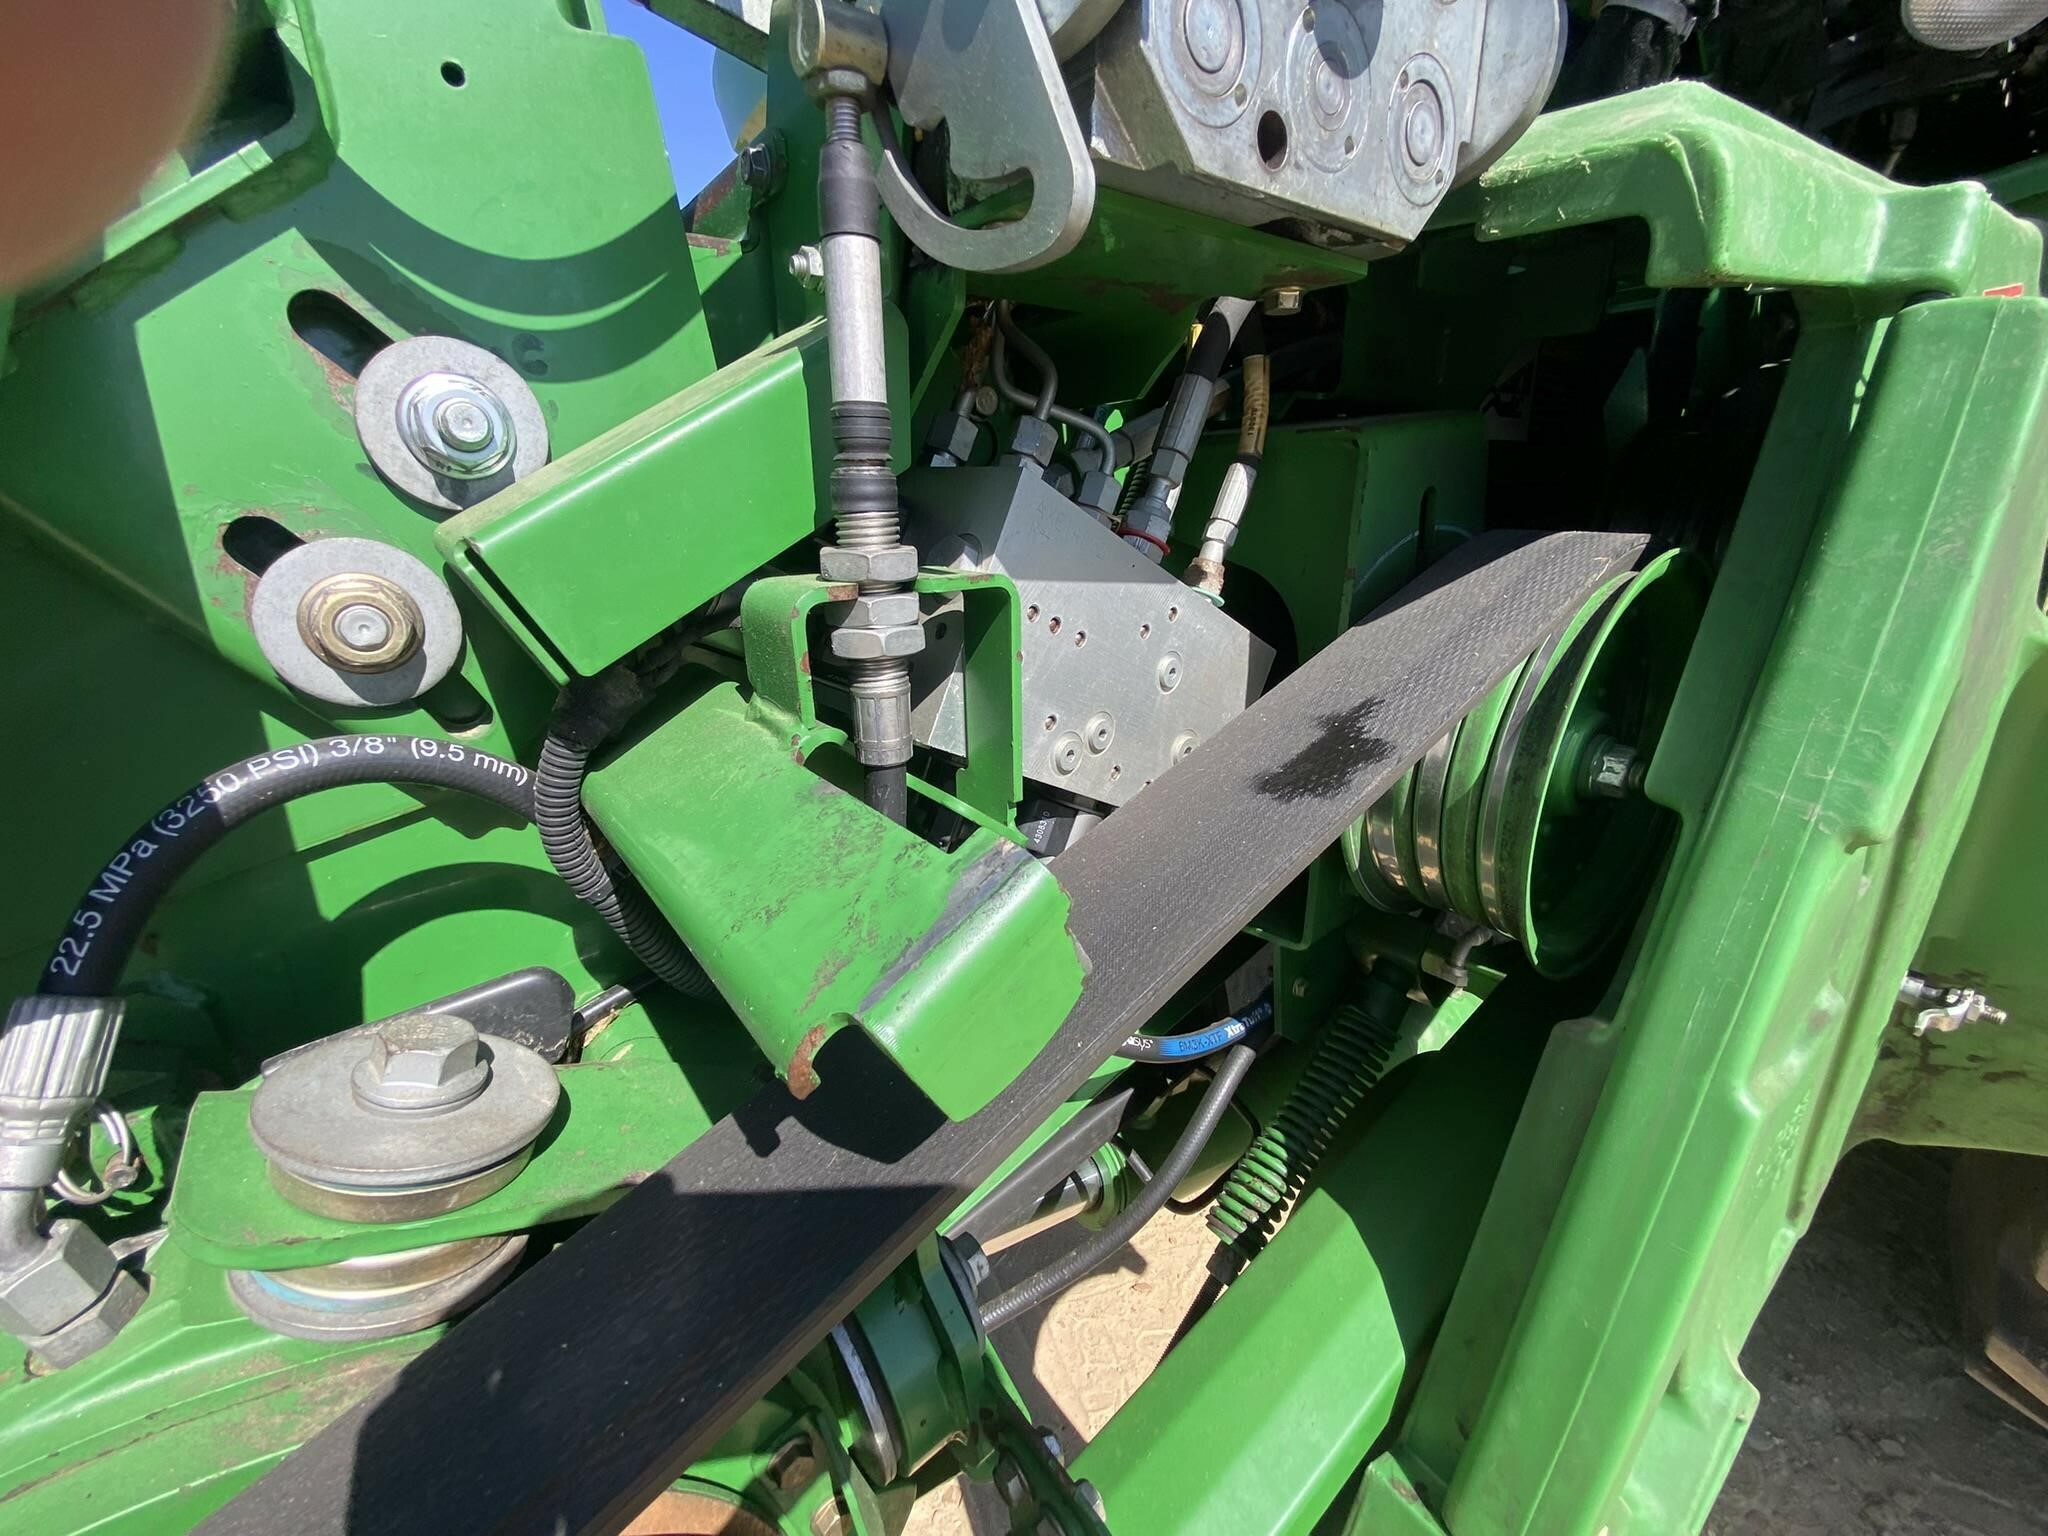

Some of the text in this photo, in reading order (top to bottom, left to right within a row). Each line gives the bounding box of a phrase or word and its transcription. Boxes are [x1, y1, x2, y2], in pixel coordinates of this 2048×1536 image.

[50, 736, 528, 977] 22.5 MPa (3250 PSI) 3/8" (9.5 mm)
